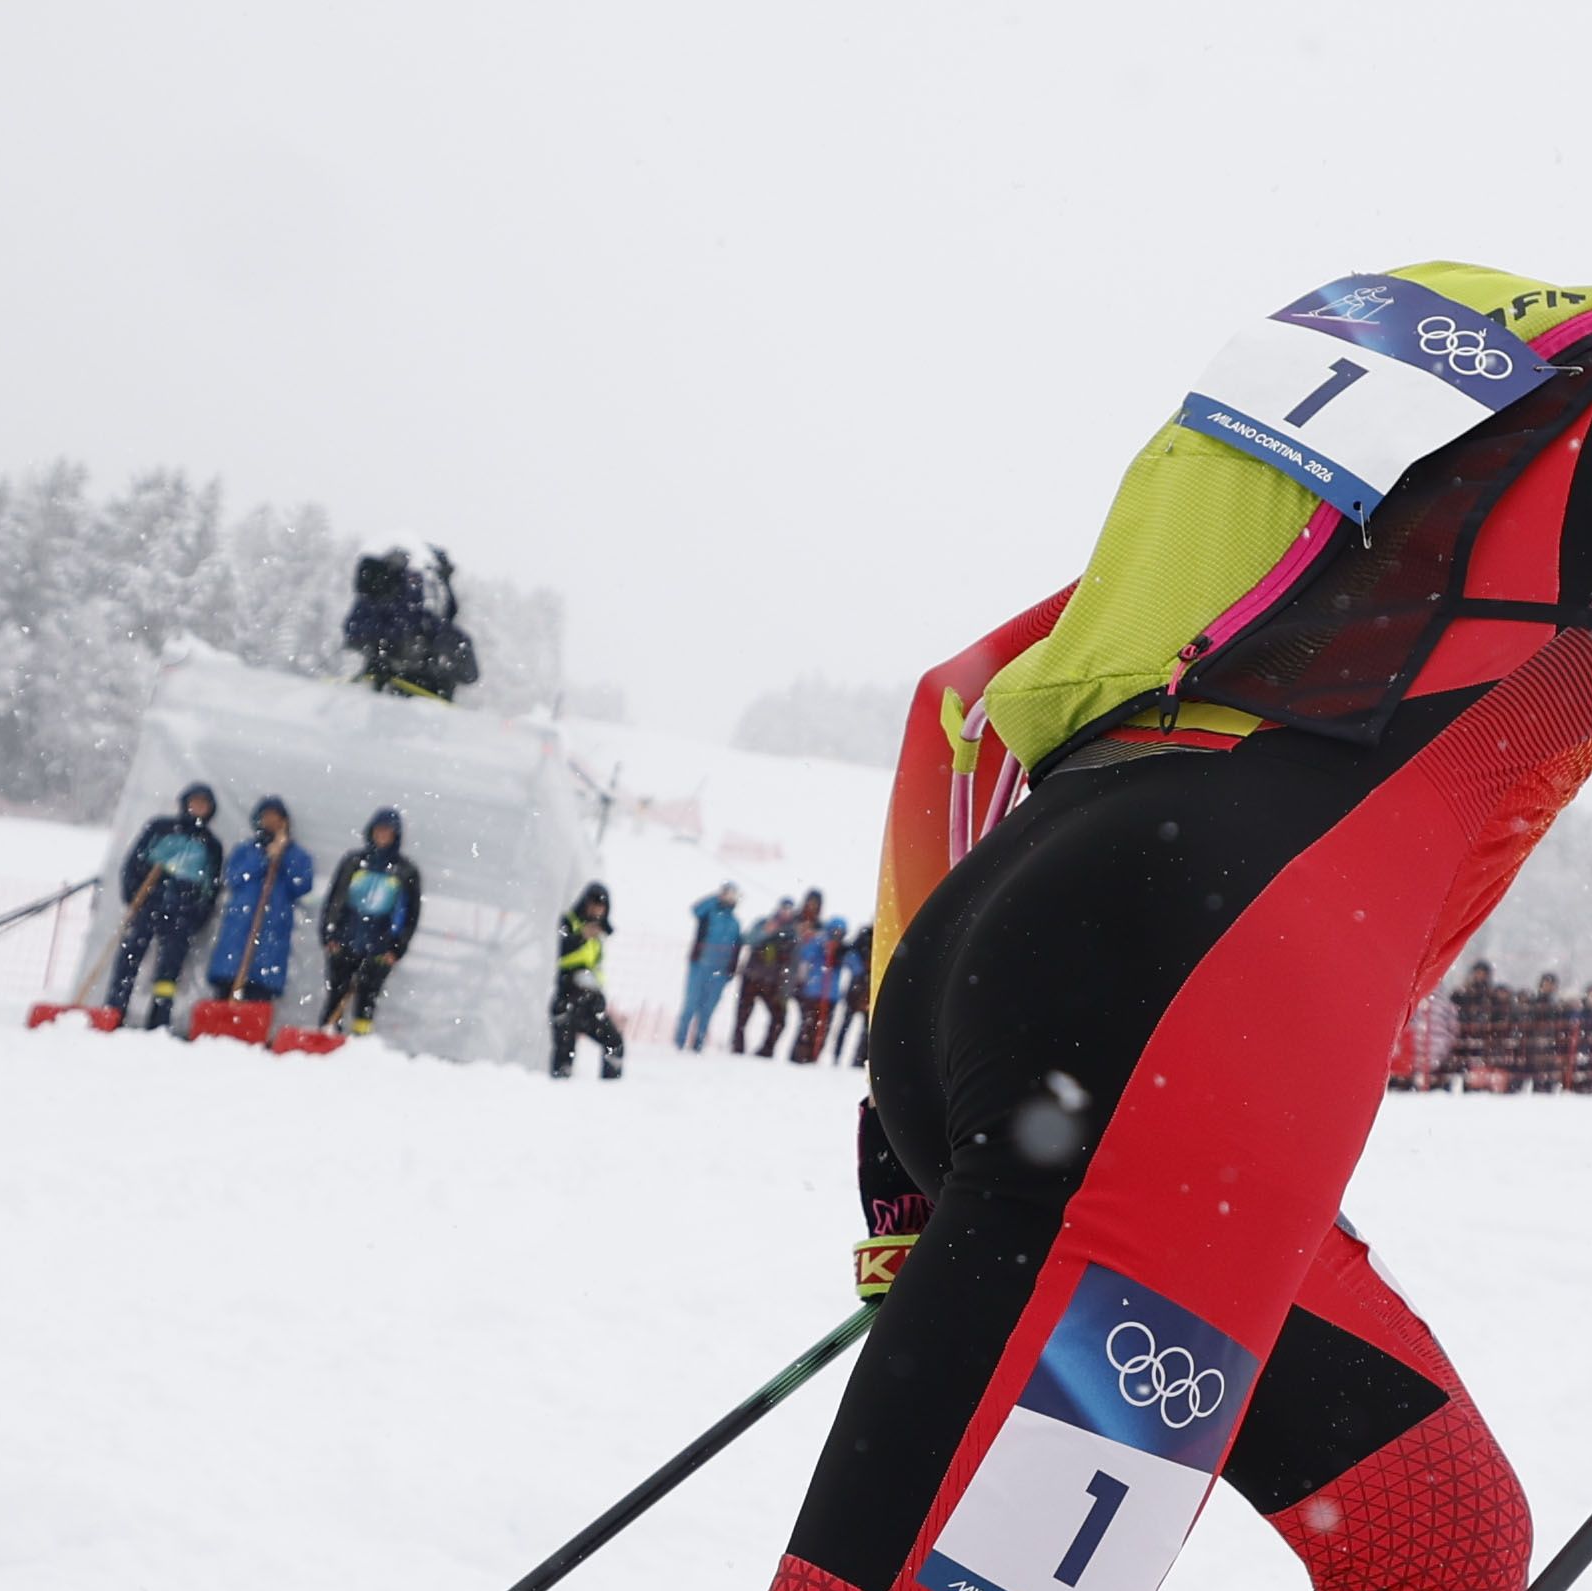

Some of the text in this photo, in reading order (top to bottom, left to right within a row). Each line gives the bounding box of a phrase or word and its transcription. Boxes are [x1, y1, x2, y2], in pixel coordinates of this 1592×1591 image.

[1283, 357, 1369, 428] 1
[1207, 411, 1335, 483] MILANO CORTINA 2026
[1053, 1470, 1130, 1588] 1
